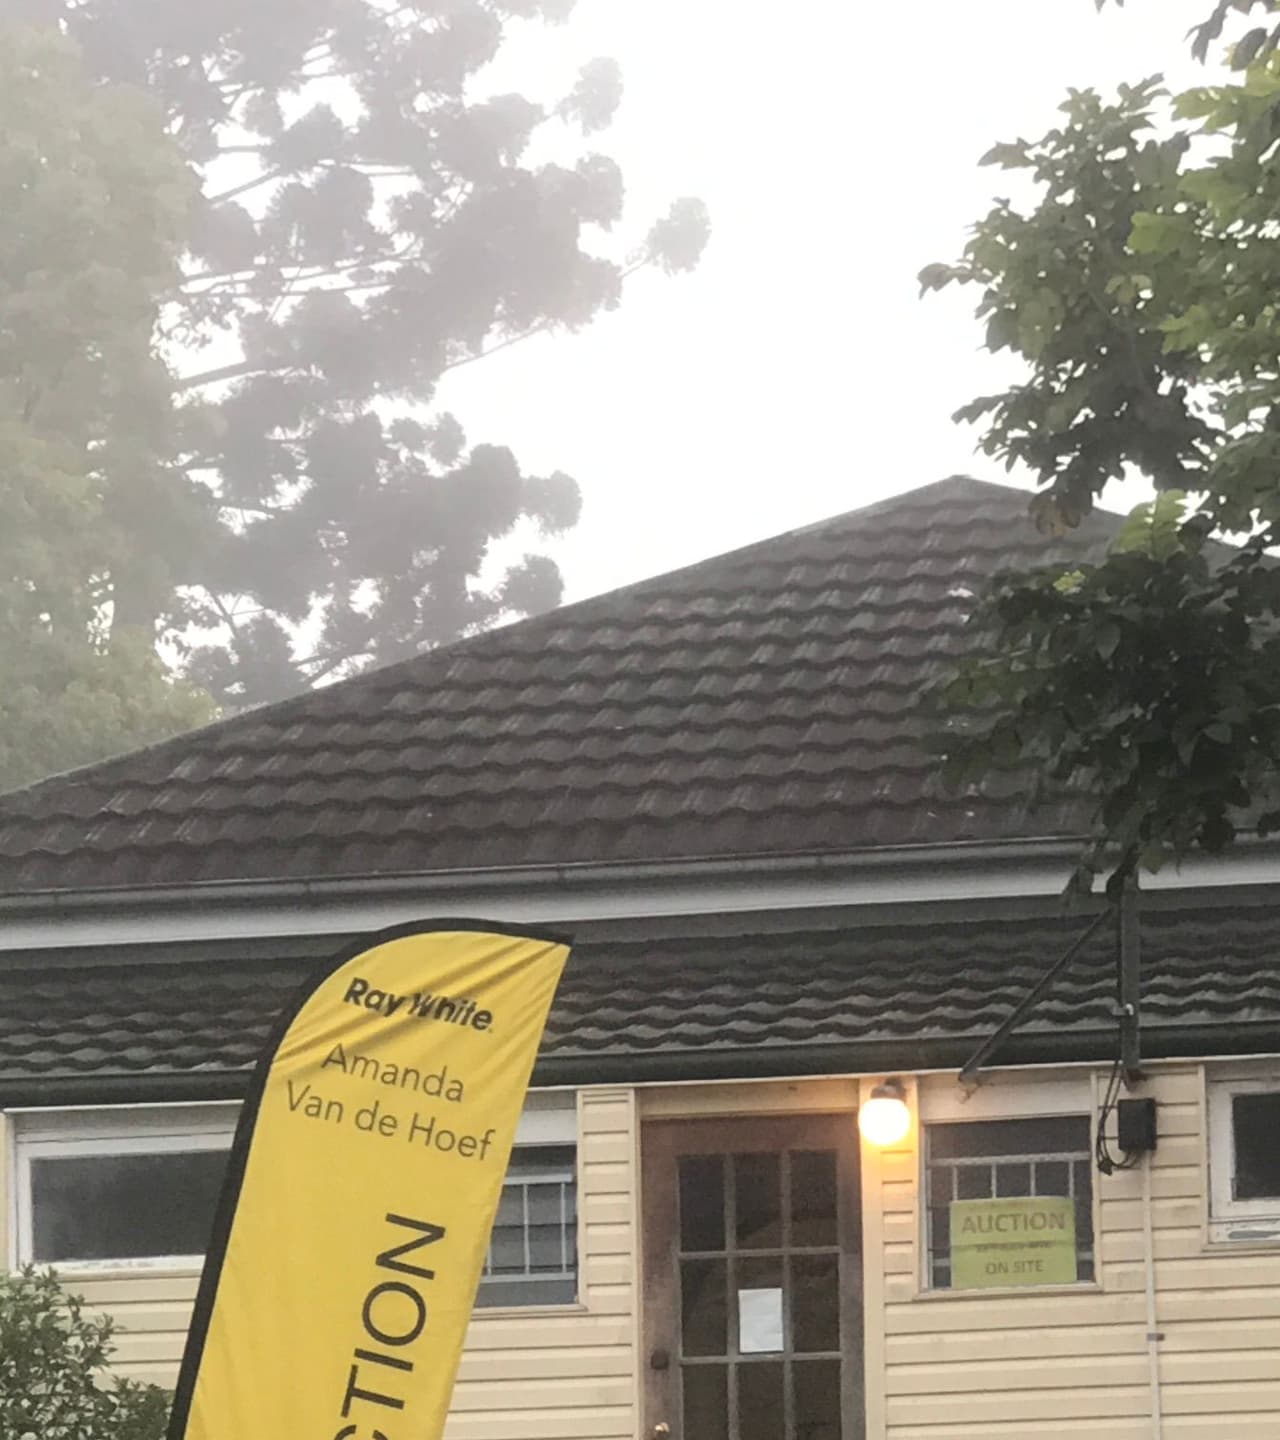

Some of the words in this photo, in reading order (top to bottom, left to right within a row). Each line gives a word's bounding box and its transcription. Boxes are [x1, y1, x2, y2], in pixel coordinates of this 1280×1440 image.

[343, 977, 406, 1018] Ray
[408, 992, 493, 1031] White
[320, 1043, 464, 1102] Amanda
[287, 1080, 344, 1124] Van
[354, 1100, 398, 1137] de
[408, 1112, 496, 1161] Hoef
[961, 1212, 1066, 1233] AUCTION
[985, 1262, 1009, 1274] ON
[1014, 1260, 1044, 1273] SITE
